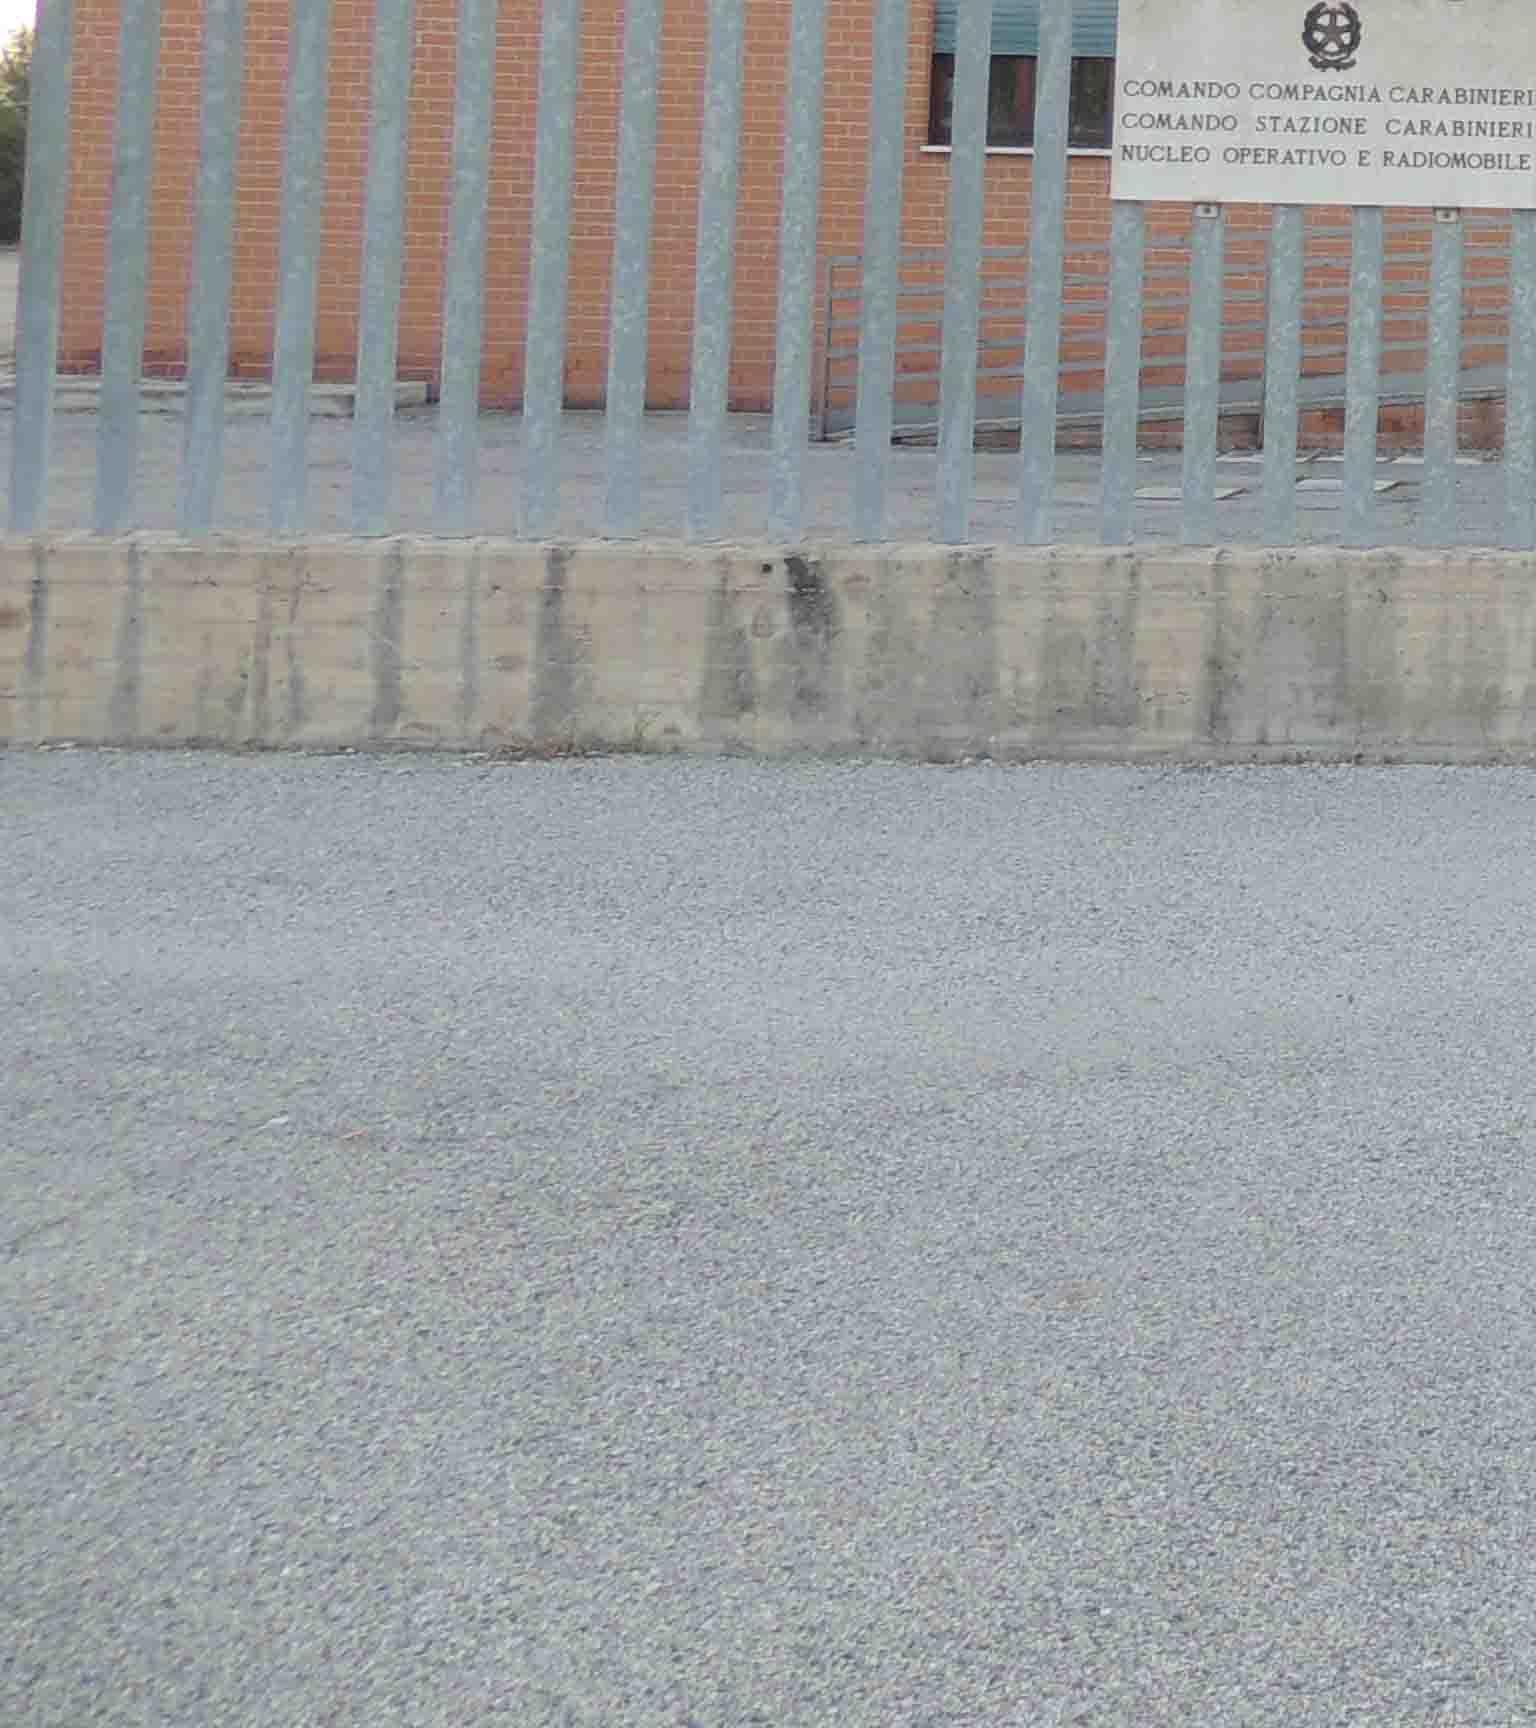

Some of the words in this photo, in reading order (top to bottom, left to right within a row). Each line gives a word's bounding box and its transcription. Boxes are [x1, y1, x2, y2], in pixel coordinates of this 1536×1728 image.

[1122, 79, 1241, 101] COMANDO
[1248, 83, 1382, 106] COMPAGNIA
[1388, 87, 1535, 108] CARABINIERI
[1121, 112, 1238, 133] COMANDO
[1255, 115, 1368, 136] STAZIONE
[1385, 119, 1533, 140] CARABINIERI
[1120, 144, 1211, 164] NUCLEO
[1223, 146, 1346, 168] OPERATIVO
[1357, 150, 1370, 167] E
[1383, 150, 1531, 171] RADIOMOBILE
